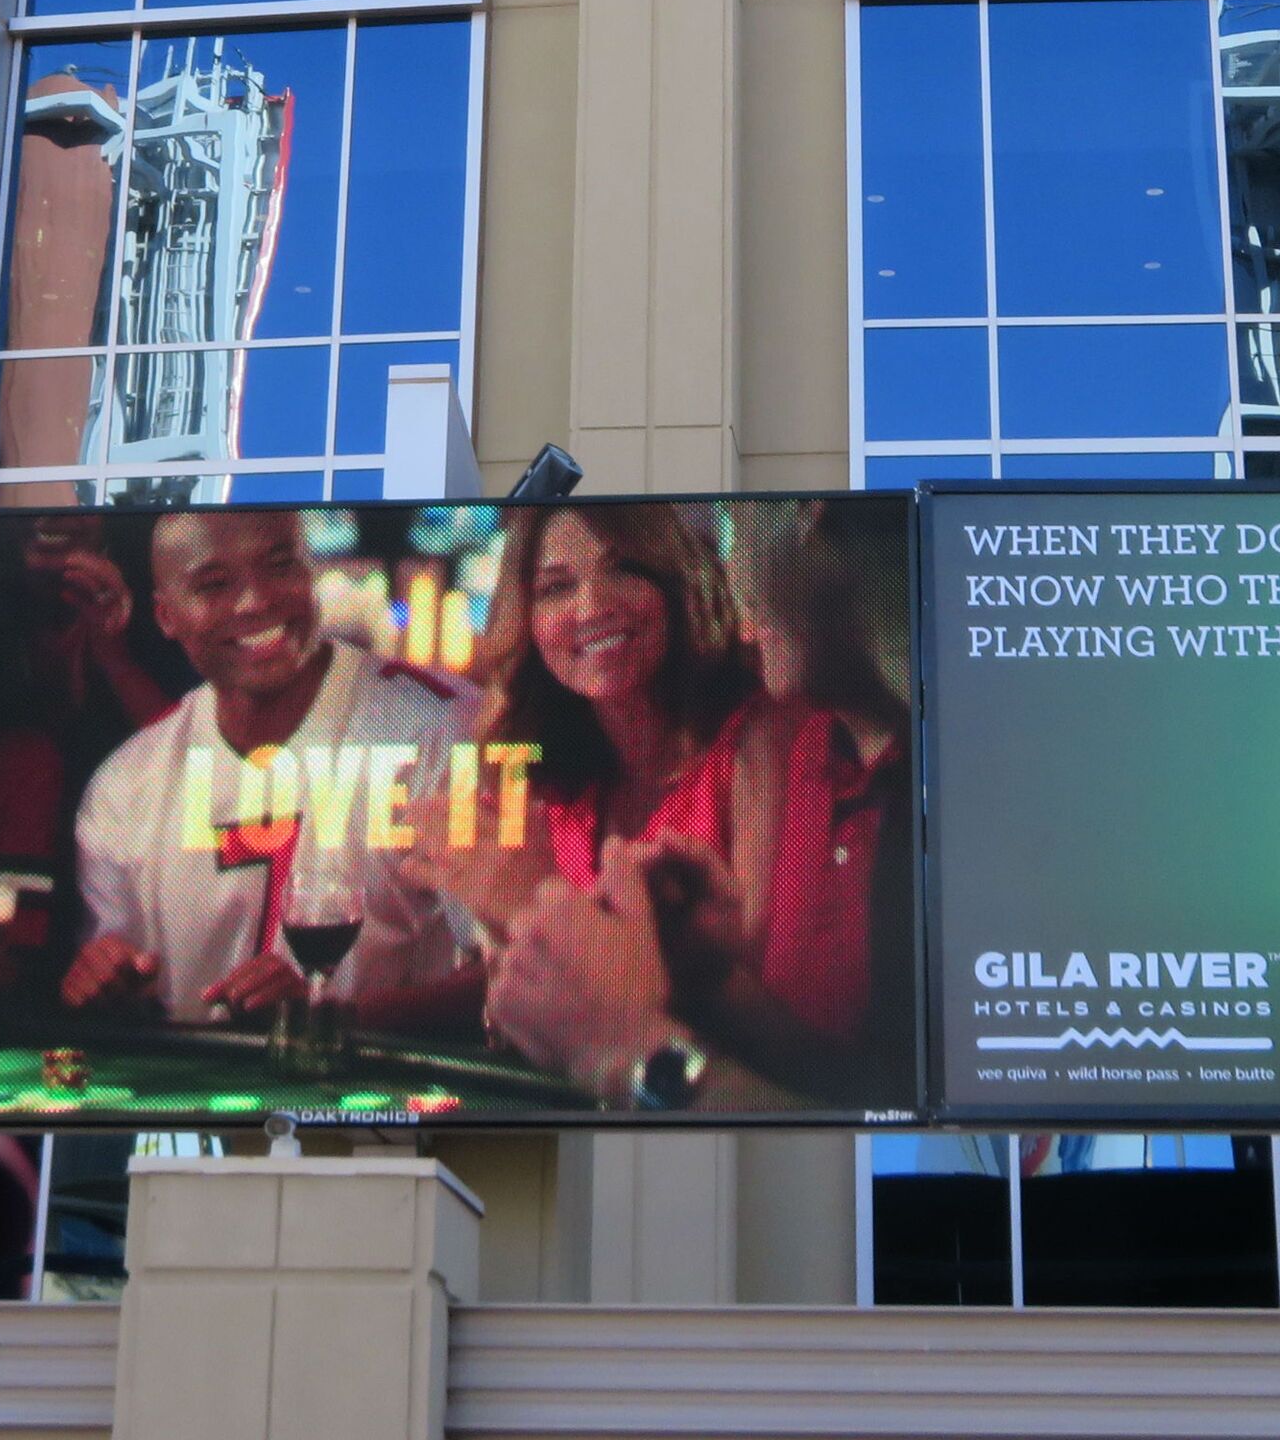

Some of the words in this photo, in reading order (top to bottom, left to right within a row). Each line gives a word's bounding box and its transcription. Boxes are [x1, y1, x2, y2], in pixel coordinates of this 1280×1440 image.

[964, 524, 1099, 556] WHEN
[1111, 523, 1225, 555] THEY
[966, 575, 1104, 606] KNOW
[1117, 574, 1227, 605] WHO
[968, 626, 1155, 658] PLAYING
[182, 743, 418, 851] LOVE
[448, 743, 543, 849] IT
[974, 952, 1098, 988] GILA
[1109, 952, 1269, 988] RIVER
[974, 1001, 1089, 1016] HOTELS
[1106, 1001, 1121, 1016] &
[1138, 1001, 1271, 1016] CASINOS
[977, 1068, 1003, 1080] vee
[1008, 1066, 1047, 1082] quiva
[1067, 1065, 1097, 1080] wild
[1101, 1065, 1142, 1080] horse
[1147, 1069, 1180, 1082] pass
[1200, 1065, 1231, 1080] lone
[1236, 1065, 1275, 1080] butte
[300, 1111, 419, 1123] DAKTRONICS
[865, 1110, 913, 1122] ProStar
